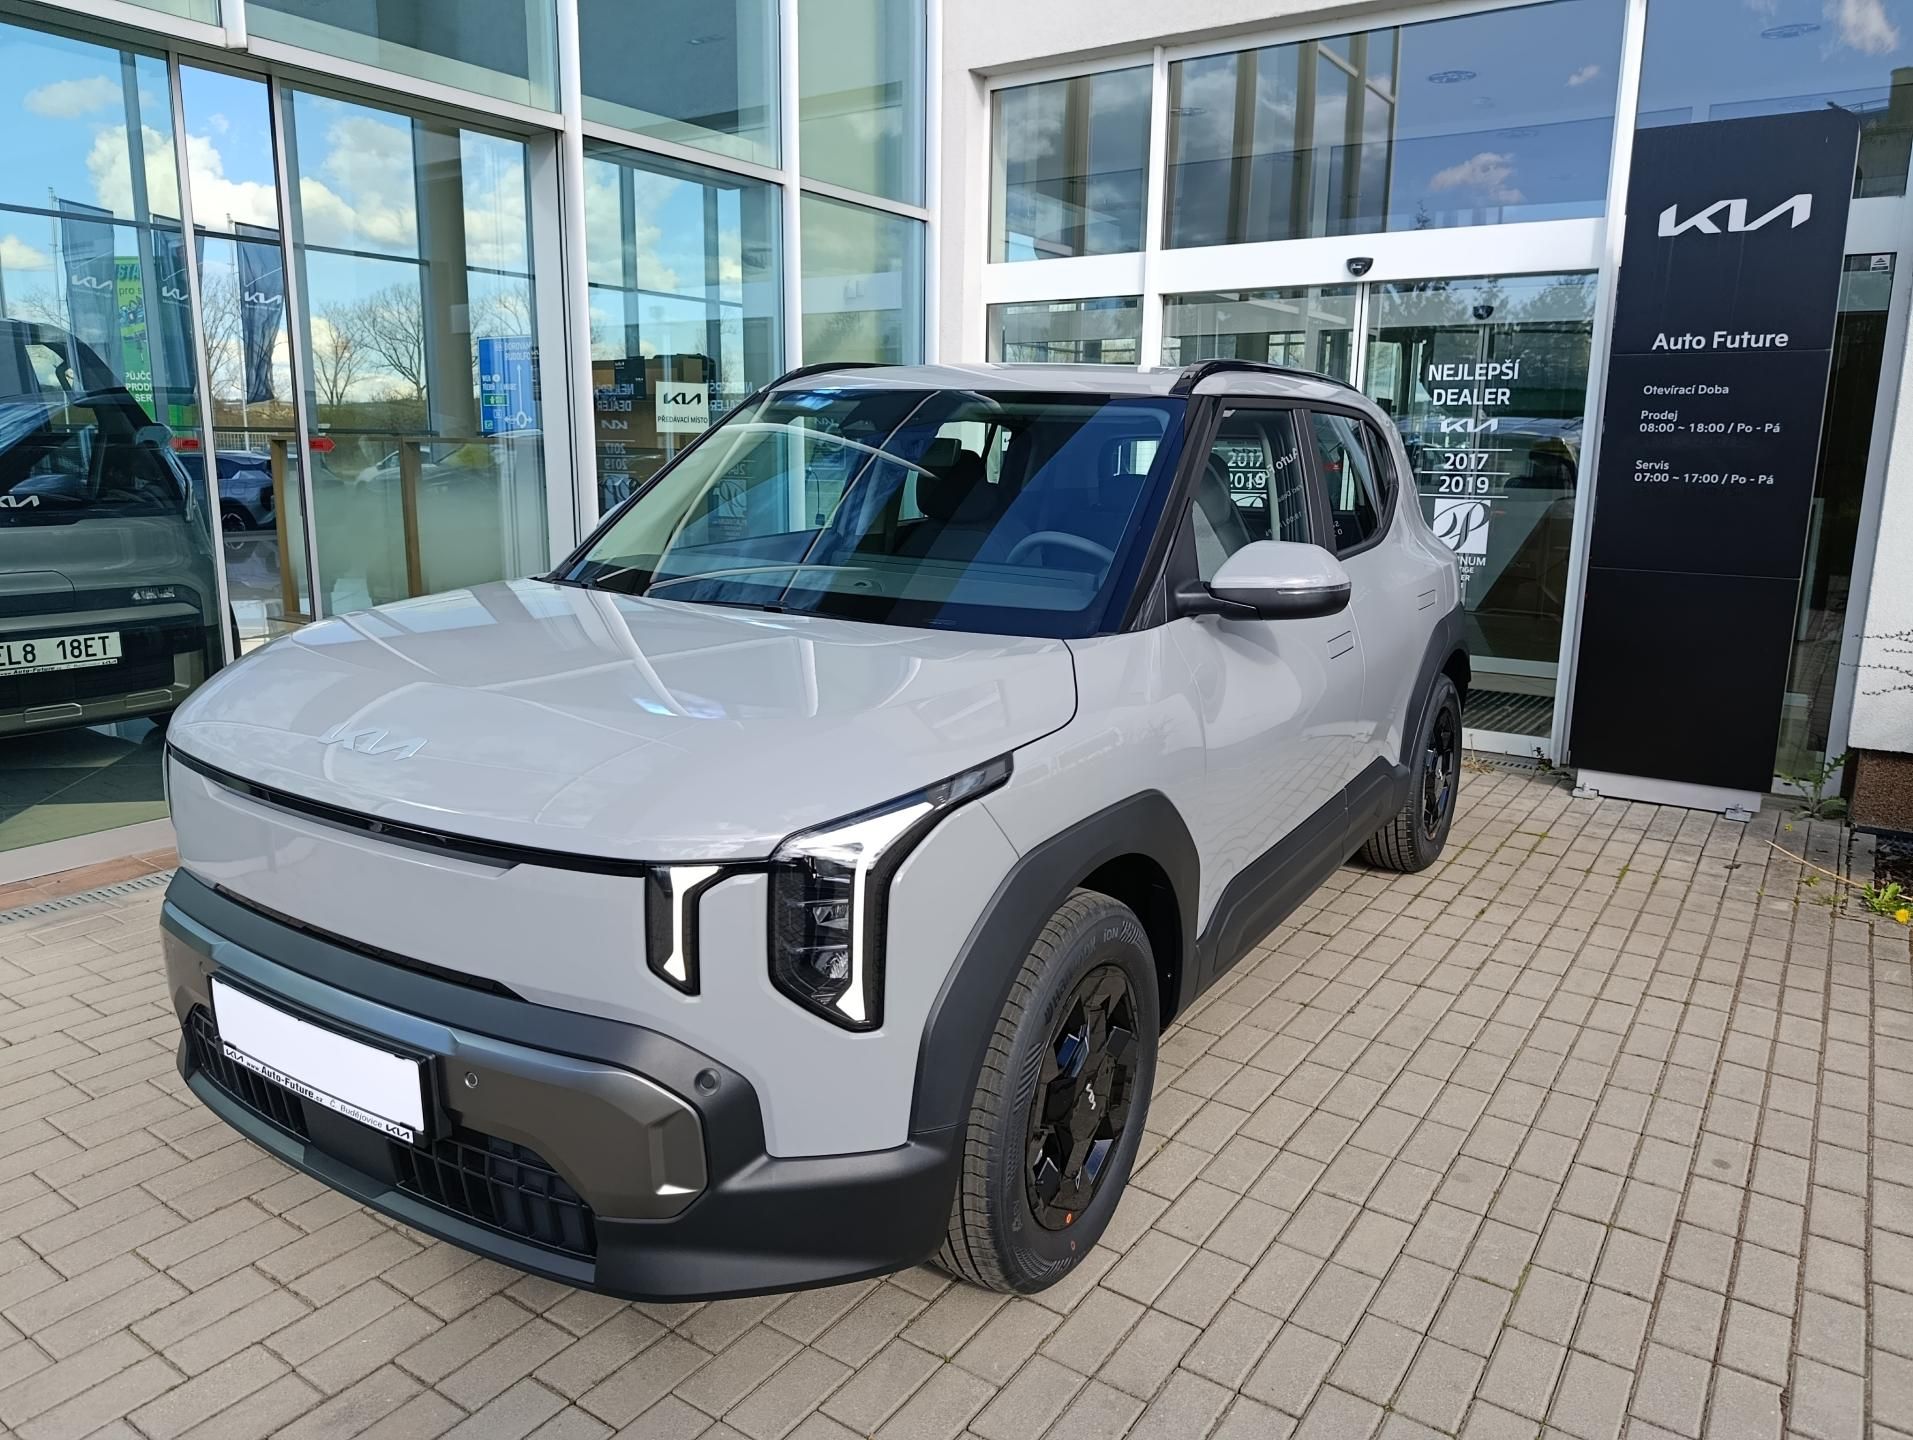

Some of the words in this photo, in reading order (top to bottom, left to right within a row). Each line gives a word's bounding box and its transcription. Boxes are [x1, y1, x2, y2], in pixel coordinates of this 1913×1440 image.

[1658, 193, 1813, 238] KIA
[72, 274, 113, 290] KIA
[245, 291, 283, 304] KIA
[1652, 333, 1706, 350] Auto
[1713, 331, 1789, 349] Future
[1428, 358, 1521, 381] NEJLEPŠÍ
[1432, 388, 1511, 405] DEALER
[1643, 384, 1697, 395] Otevírací
[1698, 384, 1730, 395] Doba
[663, 392, 702, 405] KIA
[690, 415, 708, 424] MÍSTO
[1640, 410, 1678, 422] Prodej
[1440, 418, 1499, 433] KIA
[1639, 423, 1675, 433] 08:00
[1690, 423, 1725, 433] 18:00
[1736, 423, 1753, 433] Po
[1764, 422, 1781, 433] Pá
[1443, 453, 1489, 470] 2017
[1635, 459, 1670, 470] Servis
[1438, 475, 1490, 493] 2019
[1634, 472, 1669, 483] 07:00
[1683, 473, 1719, 483] 17:00
[1730, 474, 1747, 484] Po
[1757, 474, 1774, 484] Pá
[56, 635, 110, 660] 18ET
[319, 720, 430, 761] KIA
[225, 1048, 244, 1063] KIA
[340, 1104, 383, 1129] Budějovice
[385, 1124, 410, 1140] KIA
